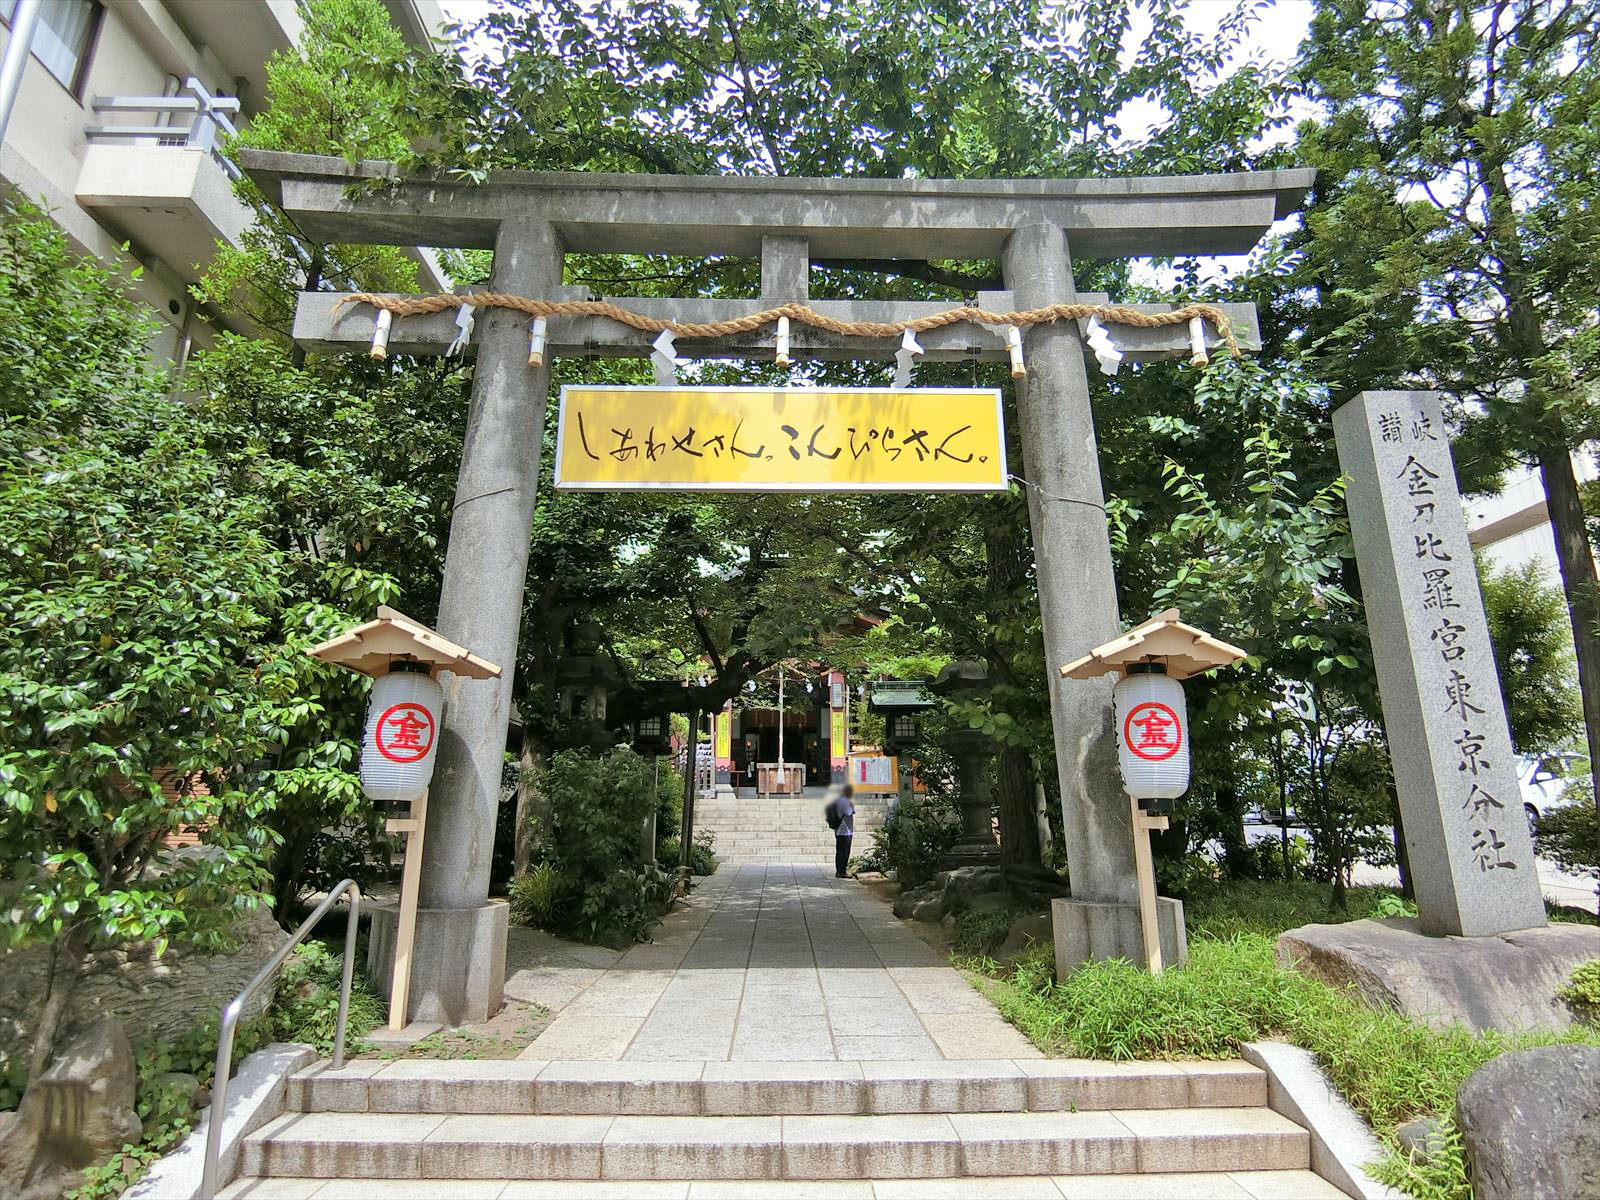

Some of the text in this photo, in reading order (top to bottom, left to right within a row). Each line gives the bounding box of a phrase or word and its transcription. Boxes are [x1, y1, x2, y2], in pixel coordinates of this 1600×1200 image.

[1396, 455, 1518, 871] 金刀比羅宮東京分社
